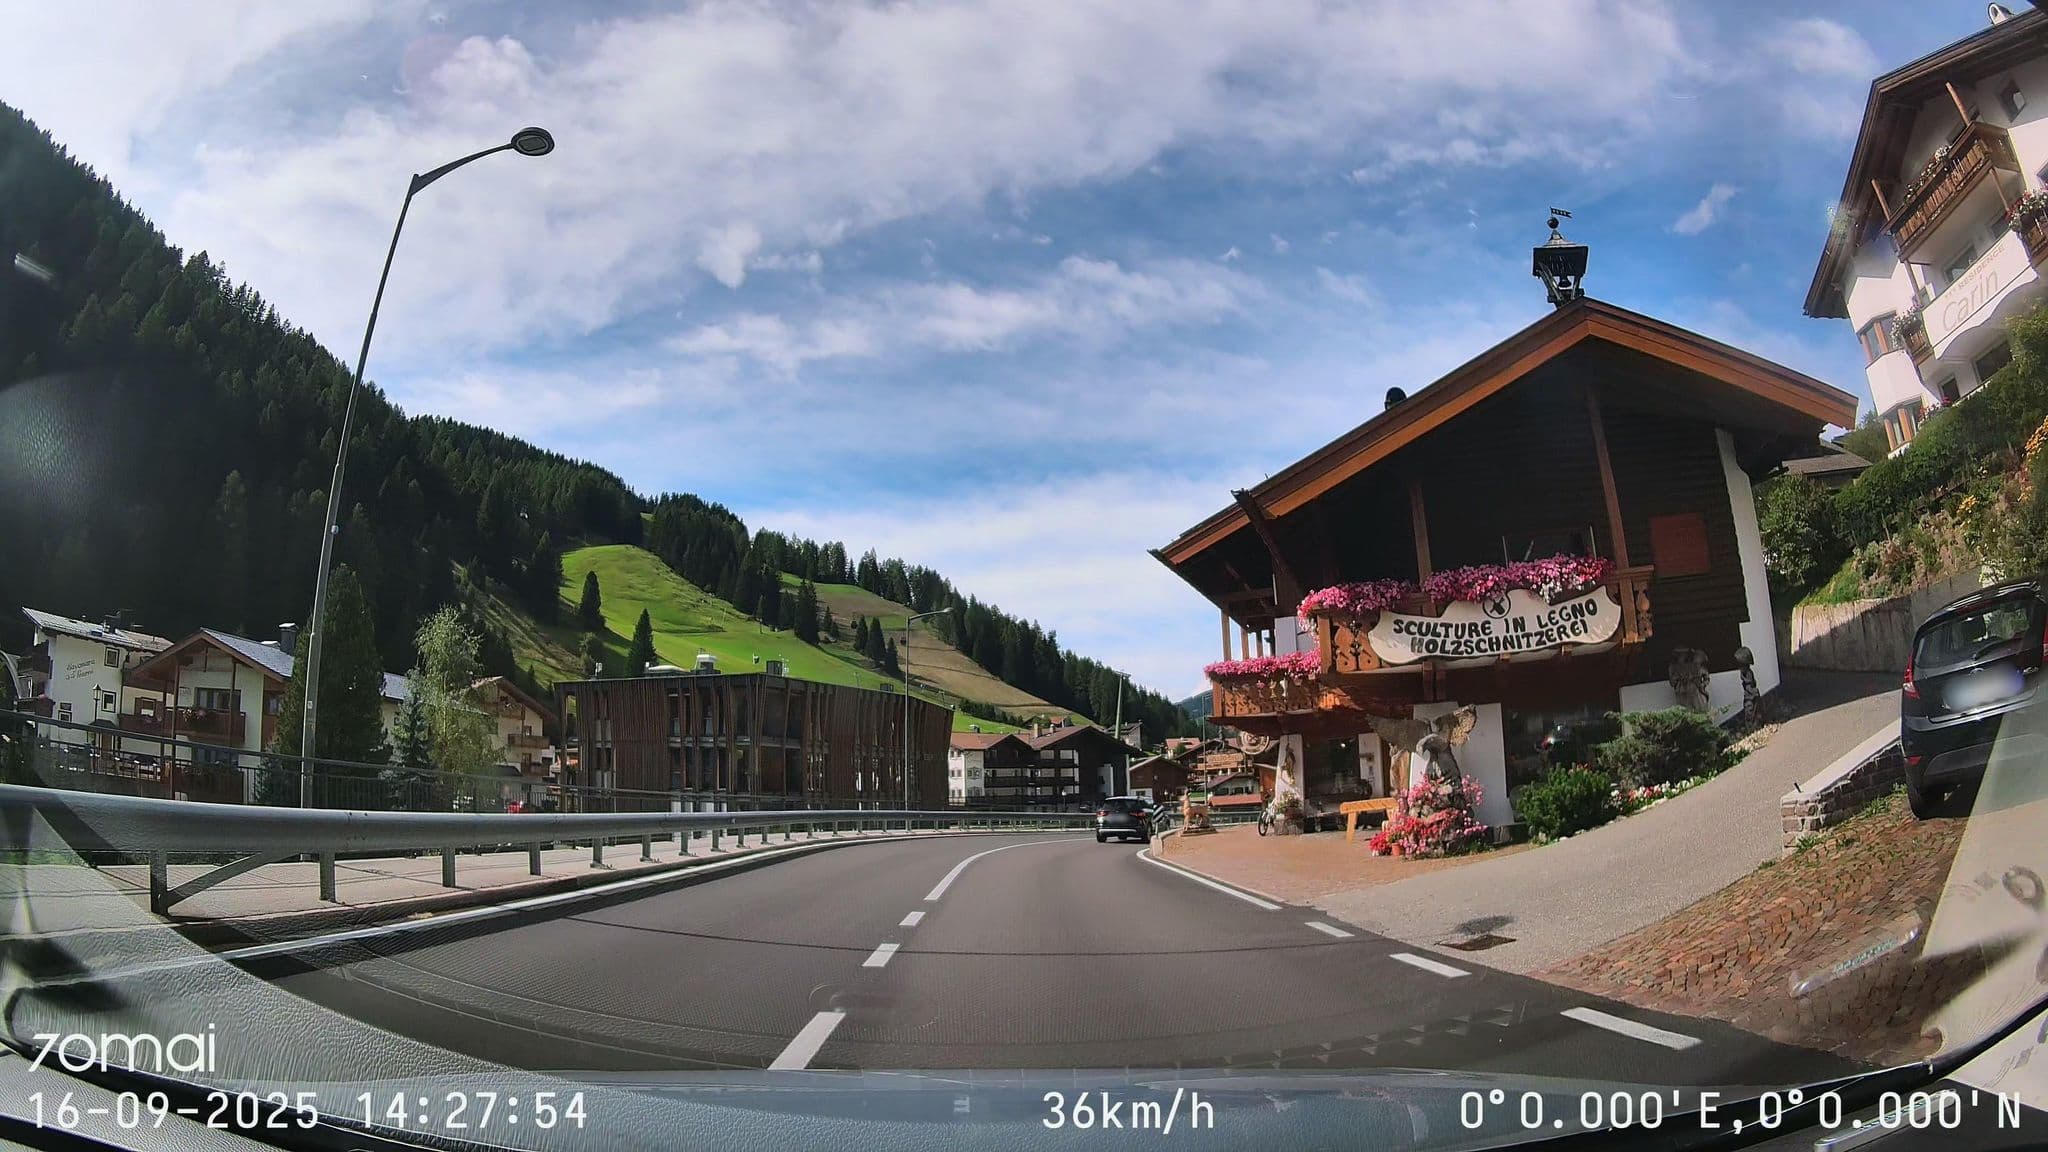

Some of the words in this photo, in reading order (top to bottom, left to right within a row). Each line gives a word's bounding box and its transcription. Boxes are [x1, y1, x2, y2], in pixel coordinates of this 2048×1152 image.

[1943, 269, 1999, 332] Carin
[1393, 618, 1493, 639] SCULTURE
[1504, 615, 1526, 634] IN
[1536, 598, 1598, 628] LEGNO
[1410, 619, 1589, 656] HOLZSCHNITZEREI
